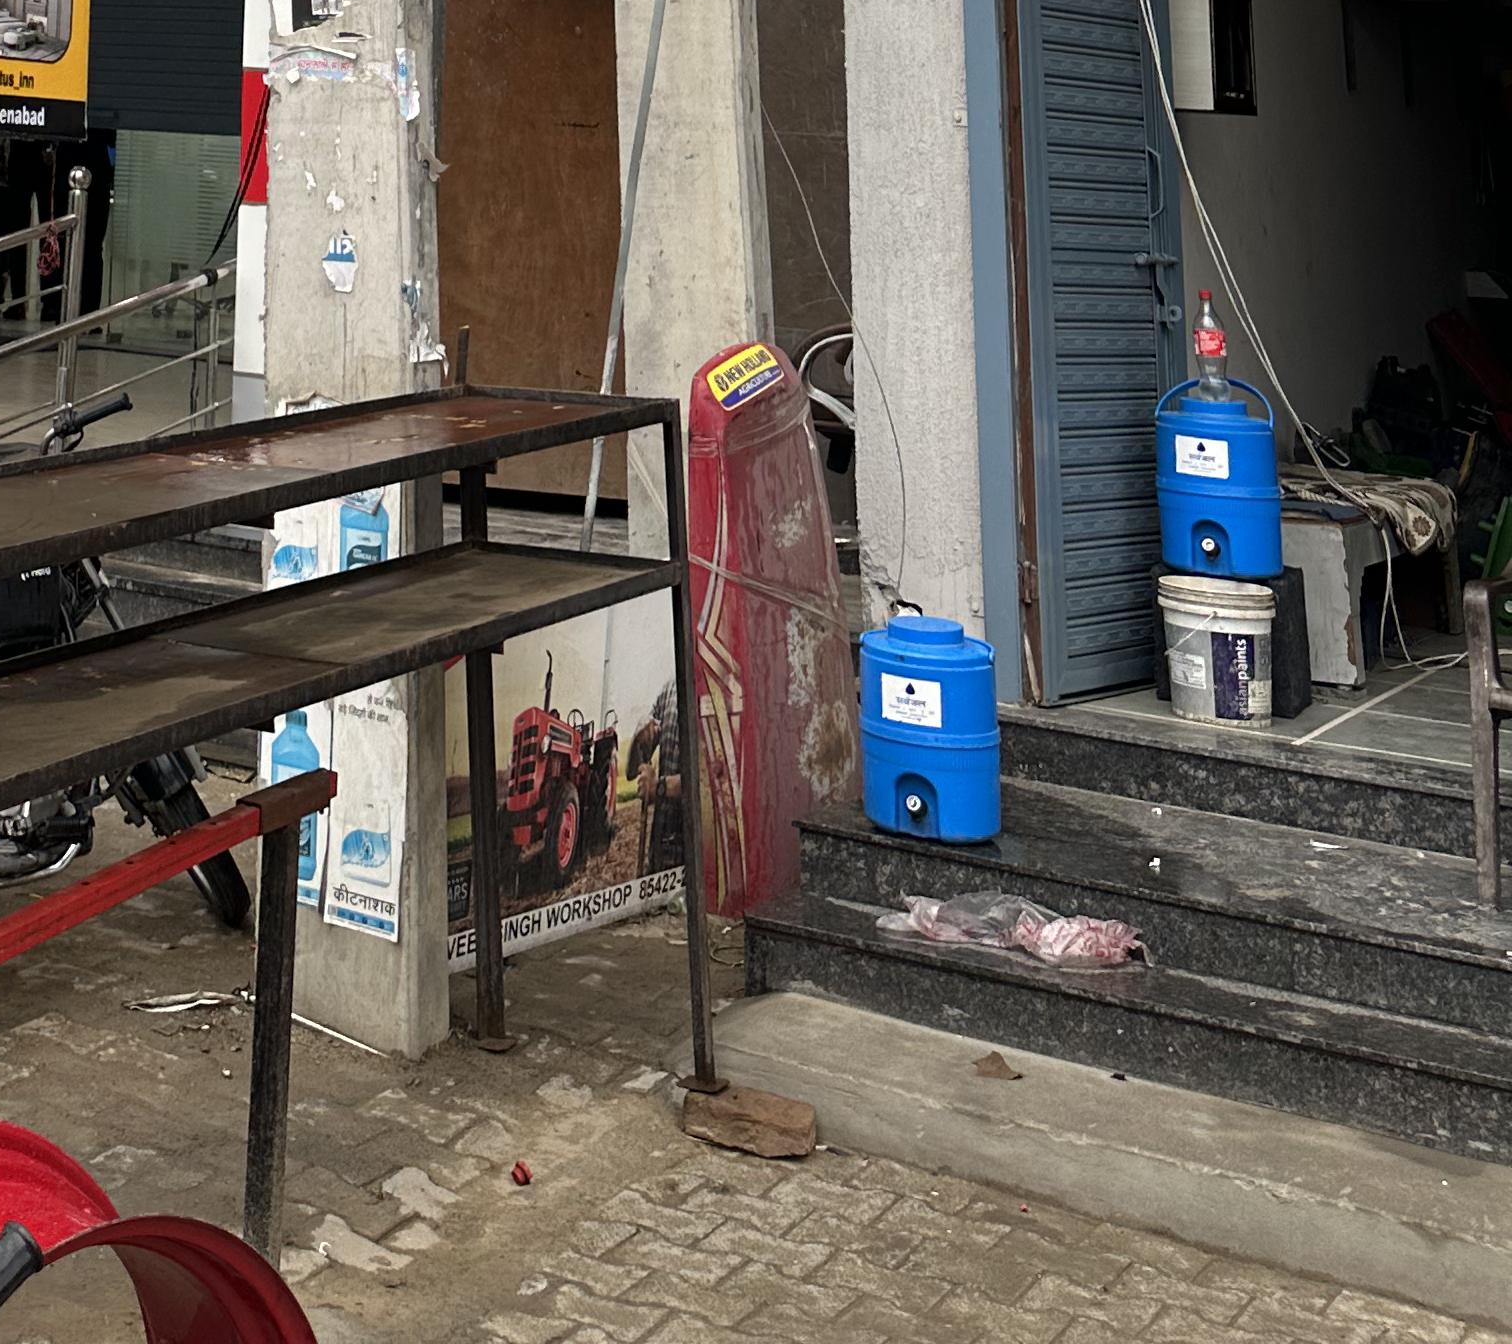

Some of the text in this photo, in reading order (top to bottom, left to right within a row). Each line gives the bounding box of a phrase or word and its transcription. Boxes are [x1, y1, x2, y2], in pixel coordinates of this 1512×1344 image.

[723, 349, 772, 385] NEW HOLLAND
[639, 867, 687, 900] 85422-2
[332, 885, 397, 917] कीटनाशक
[447, 884, 633, 961] VEE INGH WORKSHOP
